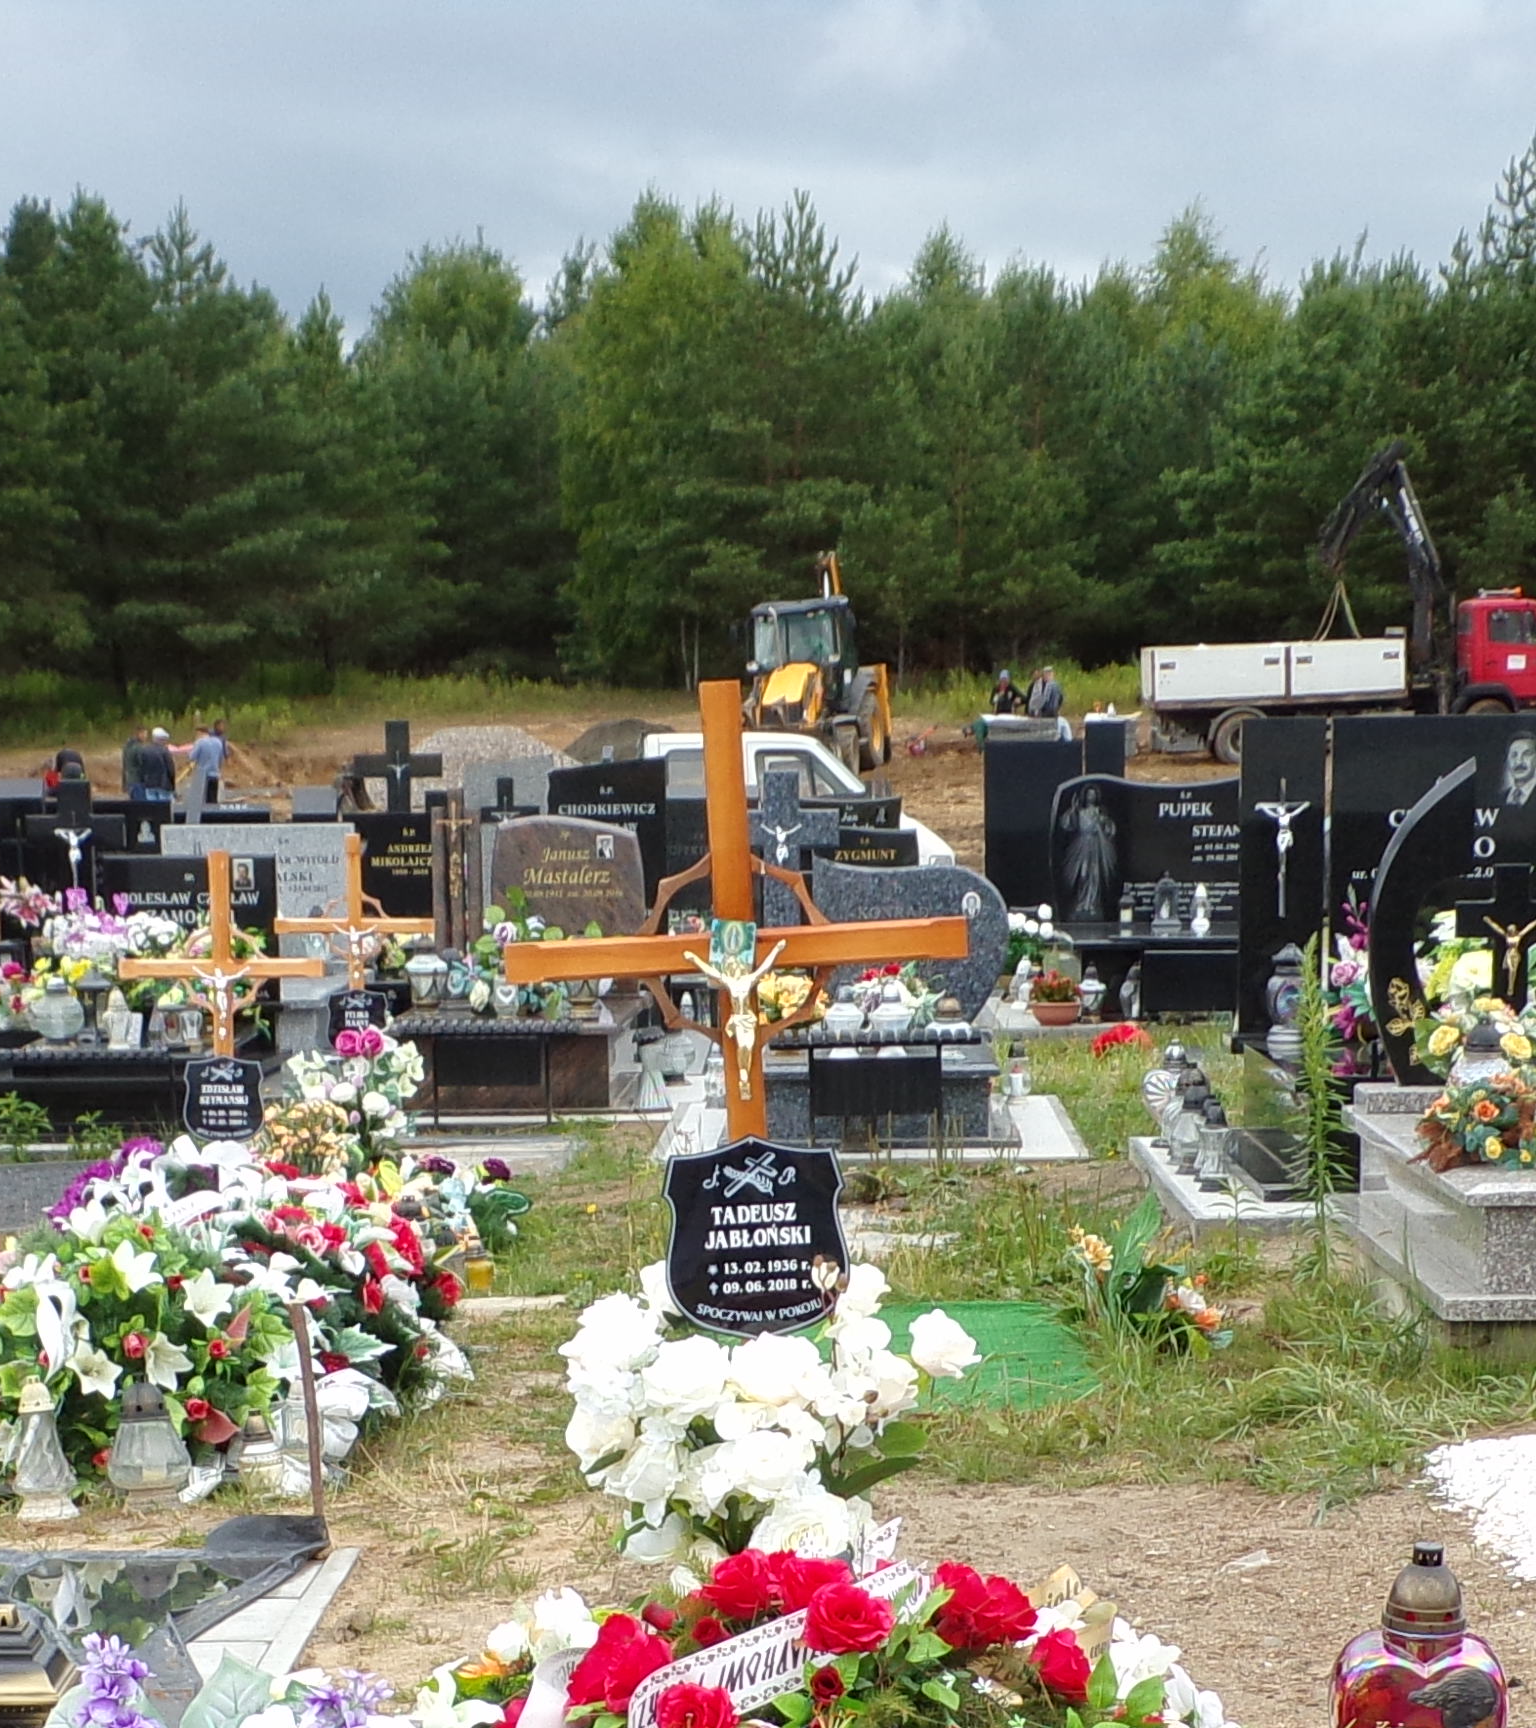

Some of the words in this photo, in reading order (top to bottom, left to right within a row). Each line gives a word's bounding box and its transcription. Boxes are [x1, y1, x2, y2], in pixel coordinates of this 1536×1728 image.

[558, 803, 656, 815] CHODKIEWICZ
[1158, 802, 1214, 818] PUPEK
[542, 847, 591, 863] Janusz
[834, 849, 897, 861] ZYGMUNT
[523, 864, 612, 885] Mastalerz
[711, 1202, 797, 1226] TADEUSZ
[704, 1223, 812, 1250] JABŁOŃSKI
[801, 1260, 812, 1271] r.
[801, 1279, 812, 1290] r.
[696, 1303, 763, 1322] SPOCZYWAJ
[766, 1310, 777, 1321] W
[779, 1297, 823, 1320] POKOJU
